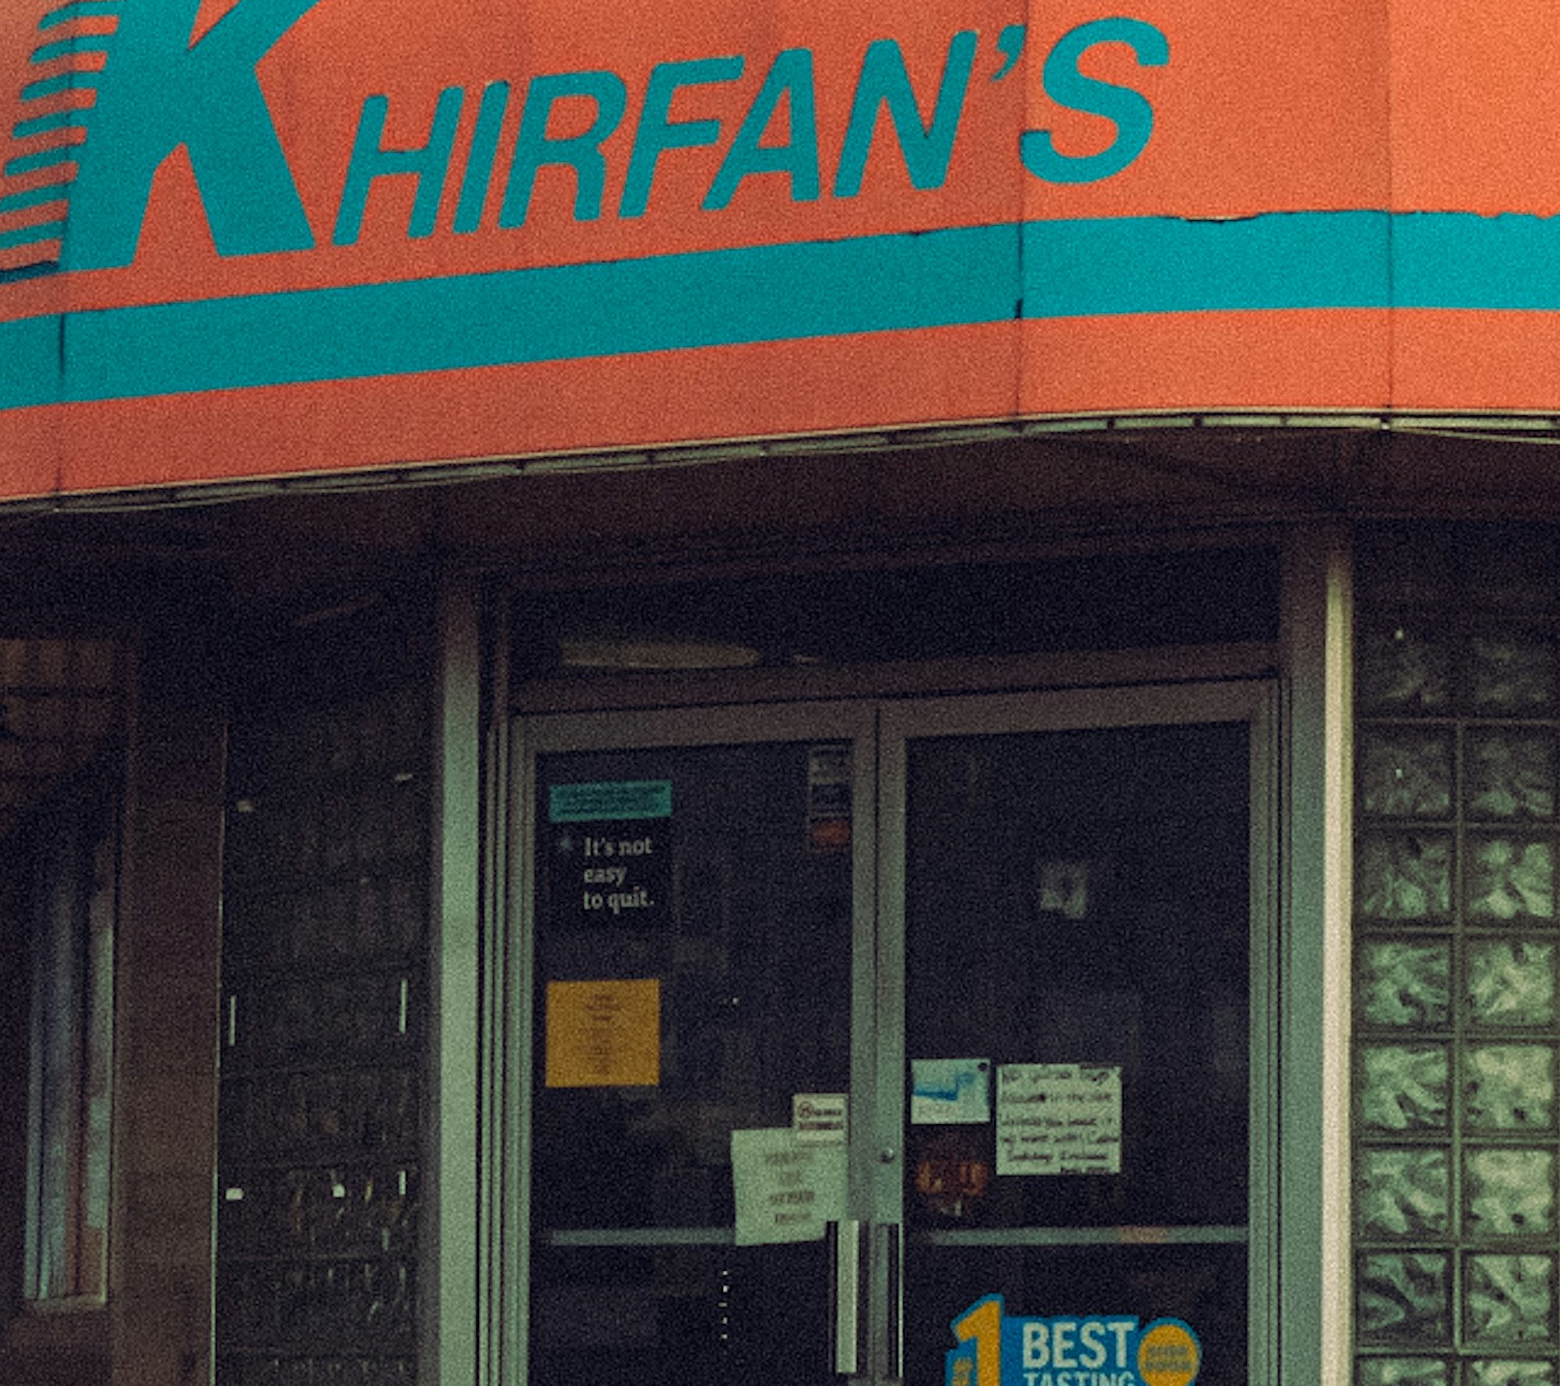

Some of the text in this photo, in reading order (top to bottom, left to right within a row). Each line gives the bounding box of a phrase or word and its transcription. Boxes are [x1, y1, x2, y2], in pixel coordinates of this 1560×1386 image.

[584, 836, 652, 857] It's not
[583, 866, 627, 888] easy
[582, 885, 655, 915] to quit.
[1022, 1321, 1137, 1370] BEST
